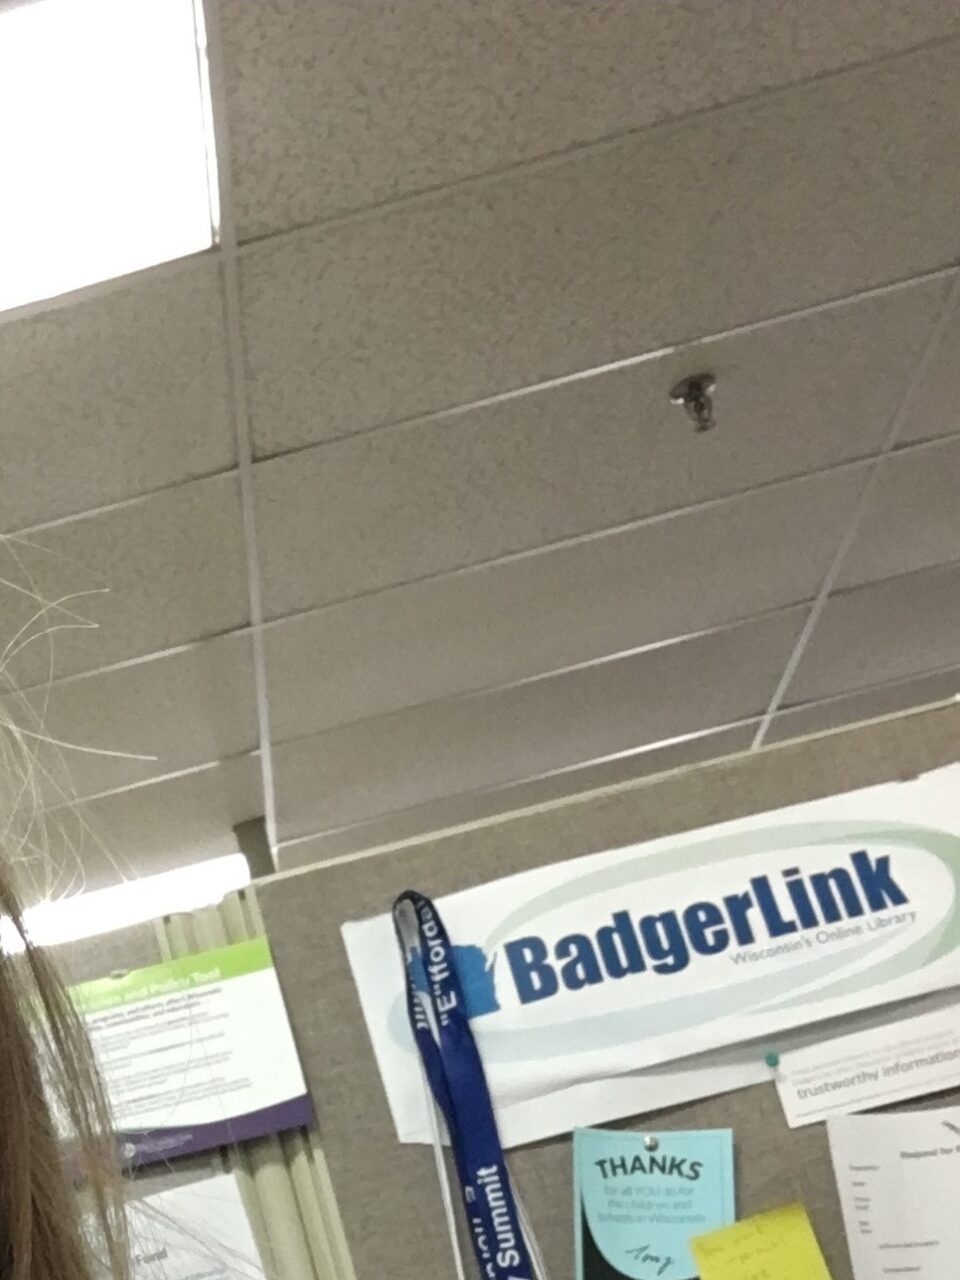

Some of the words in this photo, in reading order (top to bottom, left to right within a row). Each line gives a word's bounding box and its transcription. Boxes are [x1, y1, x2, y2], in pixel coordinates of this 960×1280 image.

[504, 850, 909, 1005] BadgerLink
[730, 935, 813, 965] Wisconsin's
[815, 924, 865, 945] Online
[866, 910, 917, 932] Library
[796, 1069, 880, 1099] trustworthy
[594, 1154, 703, 1181] THANKS
[476, 1164, 520, 1268] Summit
